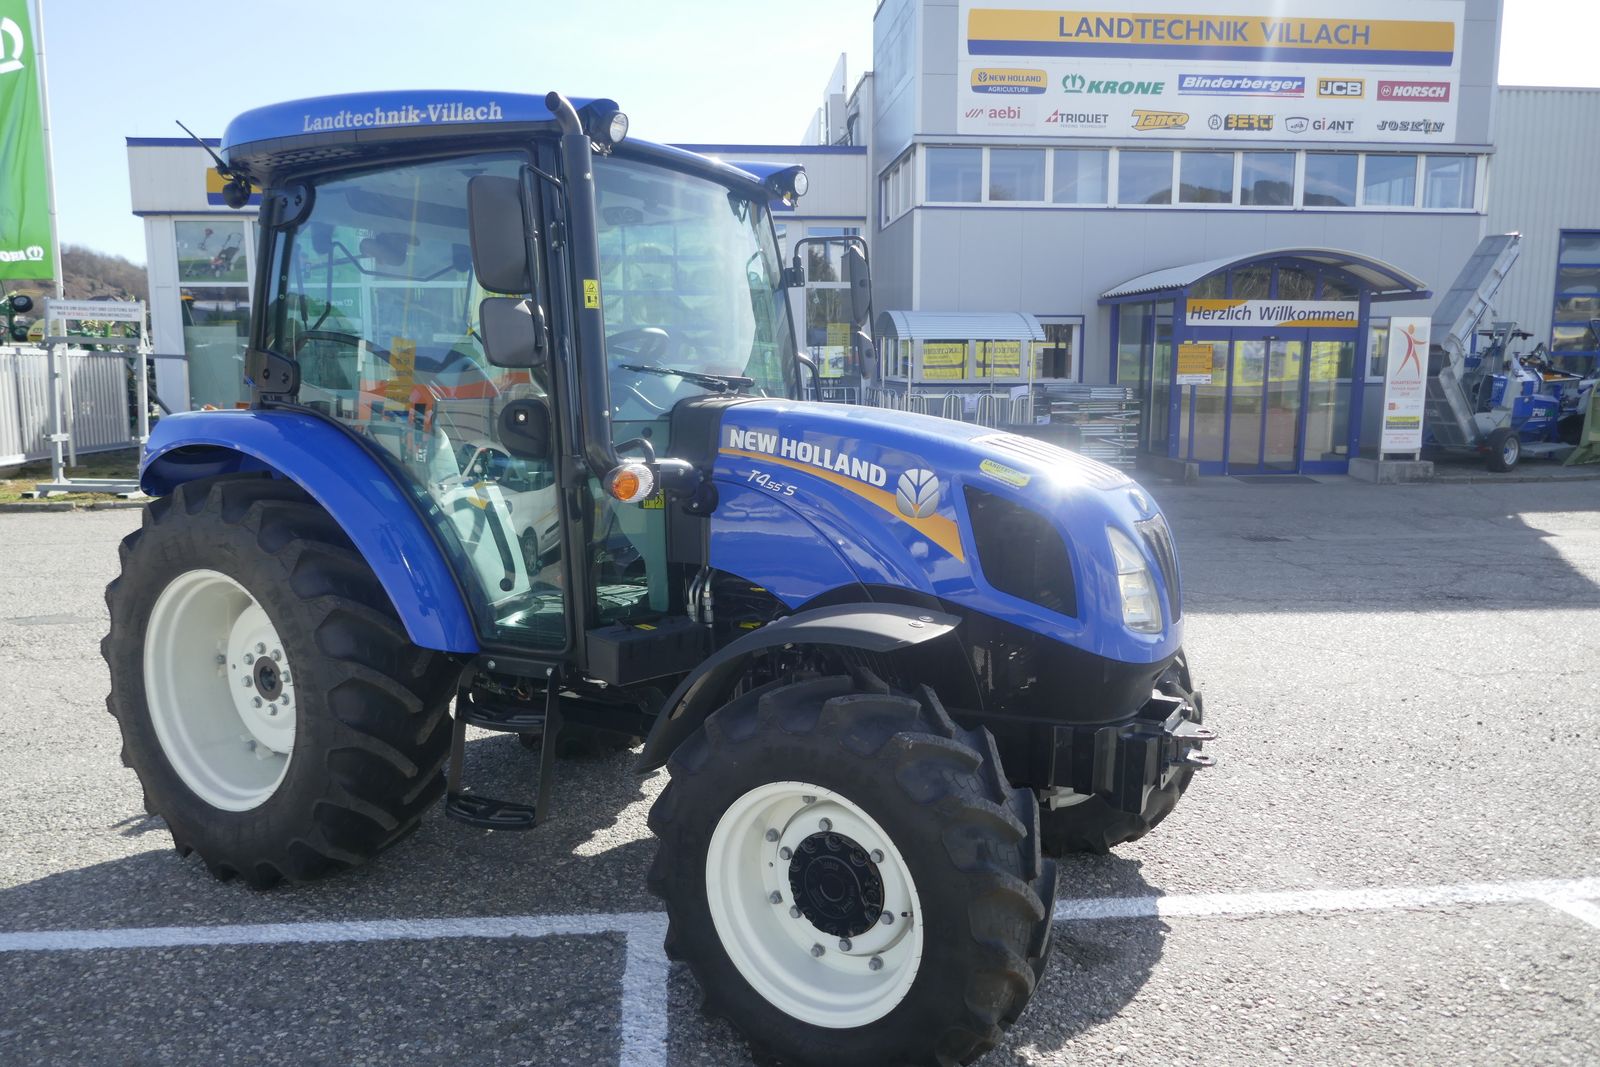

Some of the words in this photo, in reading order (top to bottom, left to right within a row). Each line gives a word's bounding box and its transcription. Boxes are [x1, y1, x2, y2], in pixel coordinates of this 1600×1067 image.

[1059, 16, 1249, 42] LANDTECHNIK
[1260, 22, 1371, 45] VILLACH
[988, 74, 1006, 82] NEW
[1007, 74, 1042, 83] HOLLAND
[1182, 76, 1302, 91] Binderberger
[1087, 80, 1166, 95] KRONE
[1320, 81, 1362, 96] JCB
[1392, 82, 1447, 98] HORSCH
[303, 101, 503, 132] Landtechnik-Villach
[988, 106, 1021, 120] aebi
[1131, 109, 1190, 131] Tanco
[1376, 118, 1446, 134] JOSKIN
[1190, 305, 1252, 321] Herzlich
[1259, 306, 1355, 321] Willkommen
[729, 429, 778, 454] NEW
[781, 437, 887, 487] HOLLAND
[783, 485, 798, 496] S
